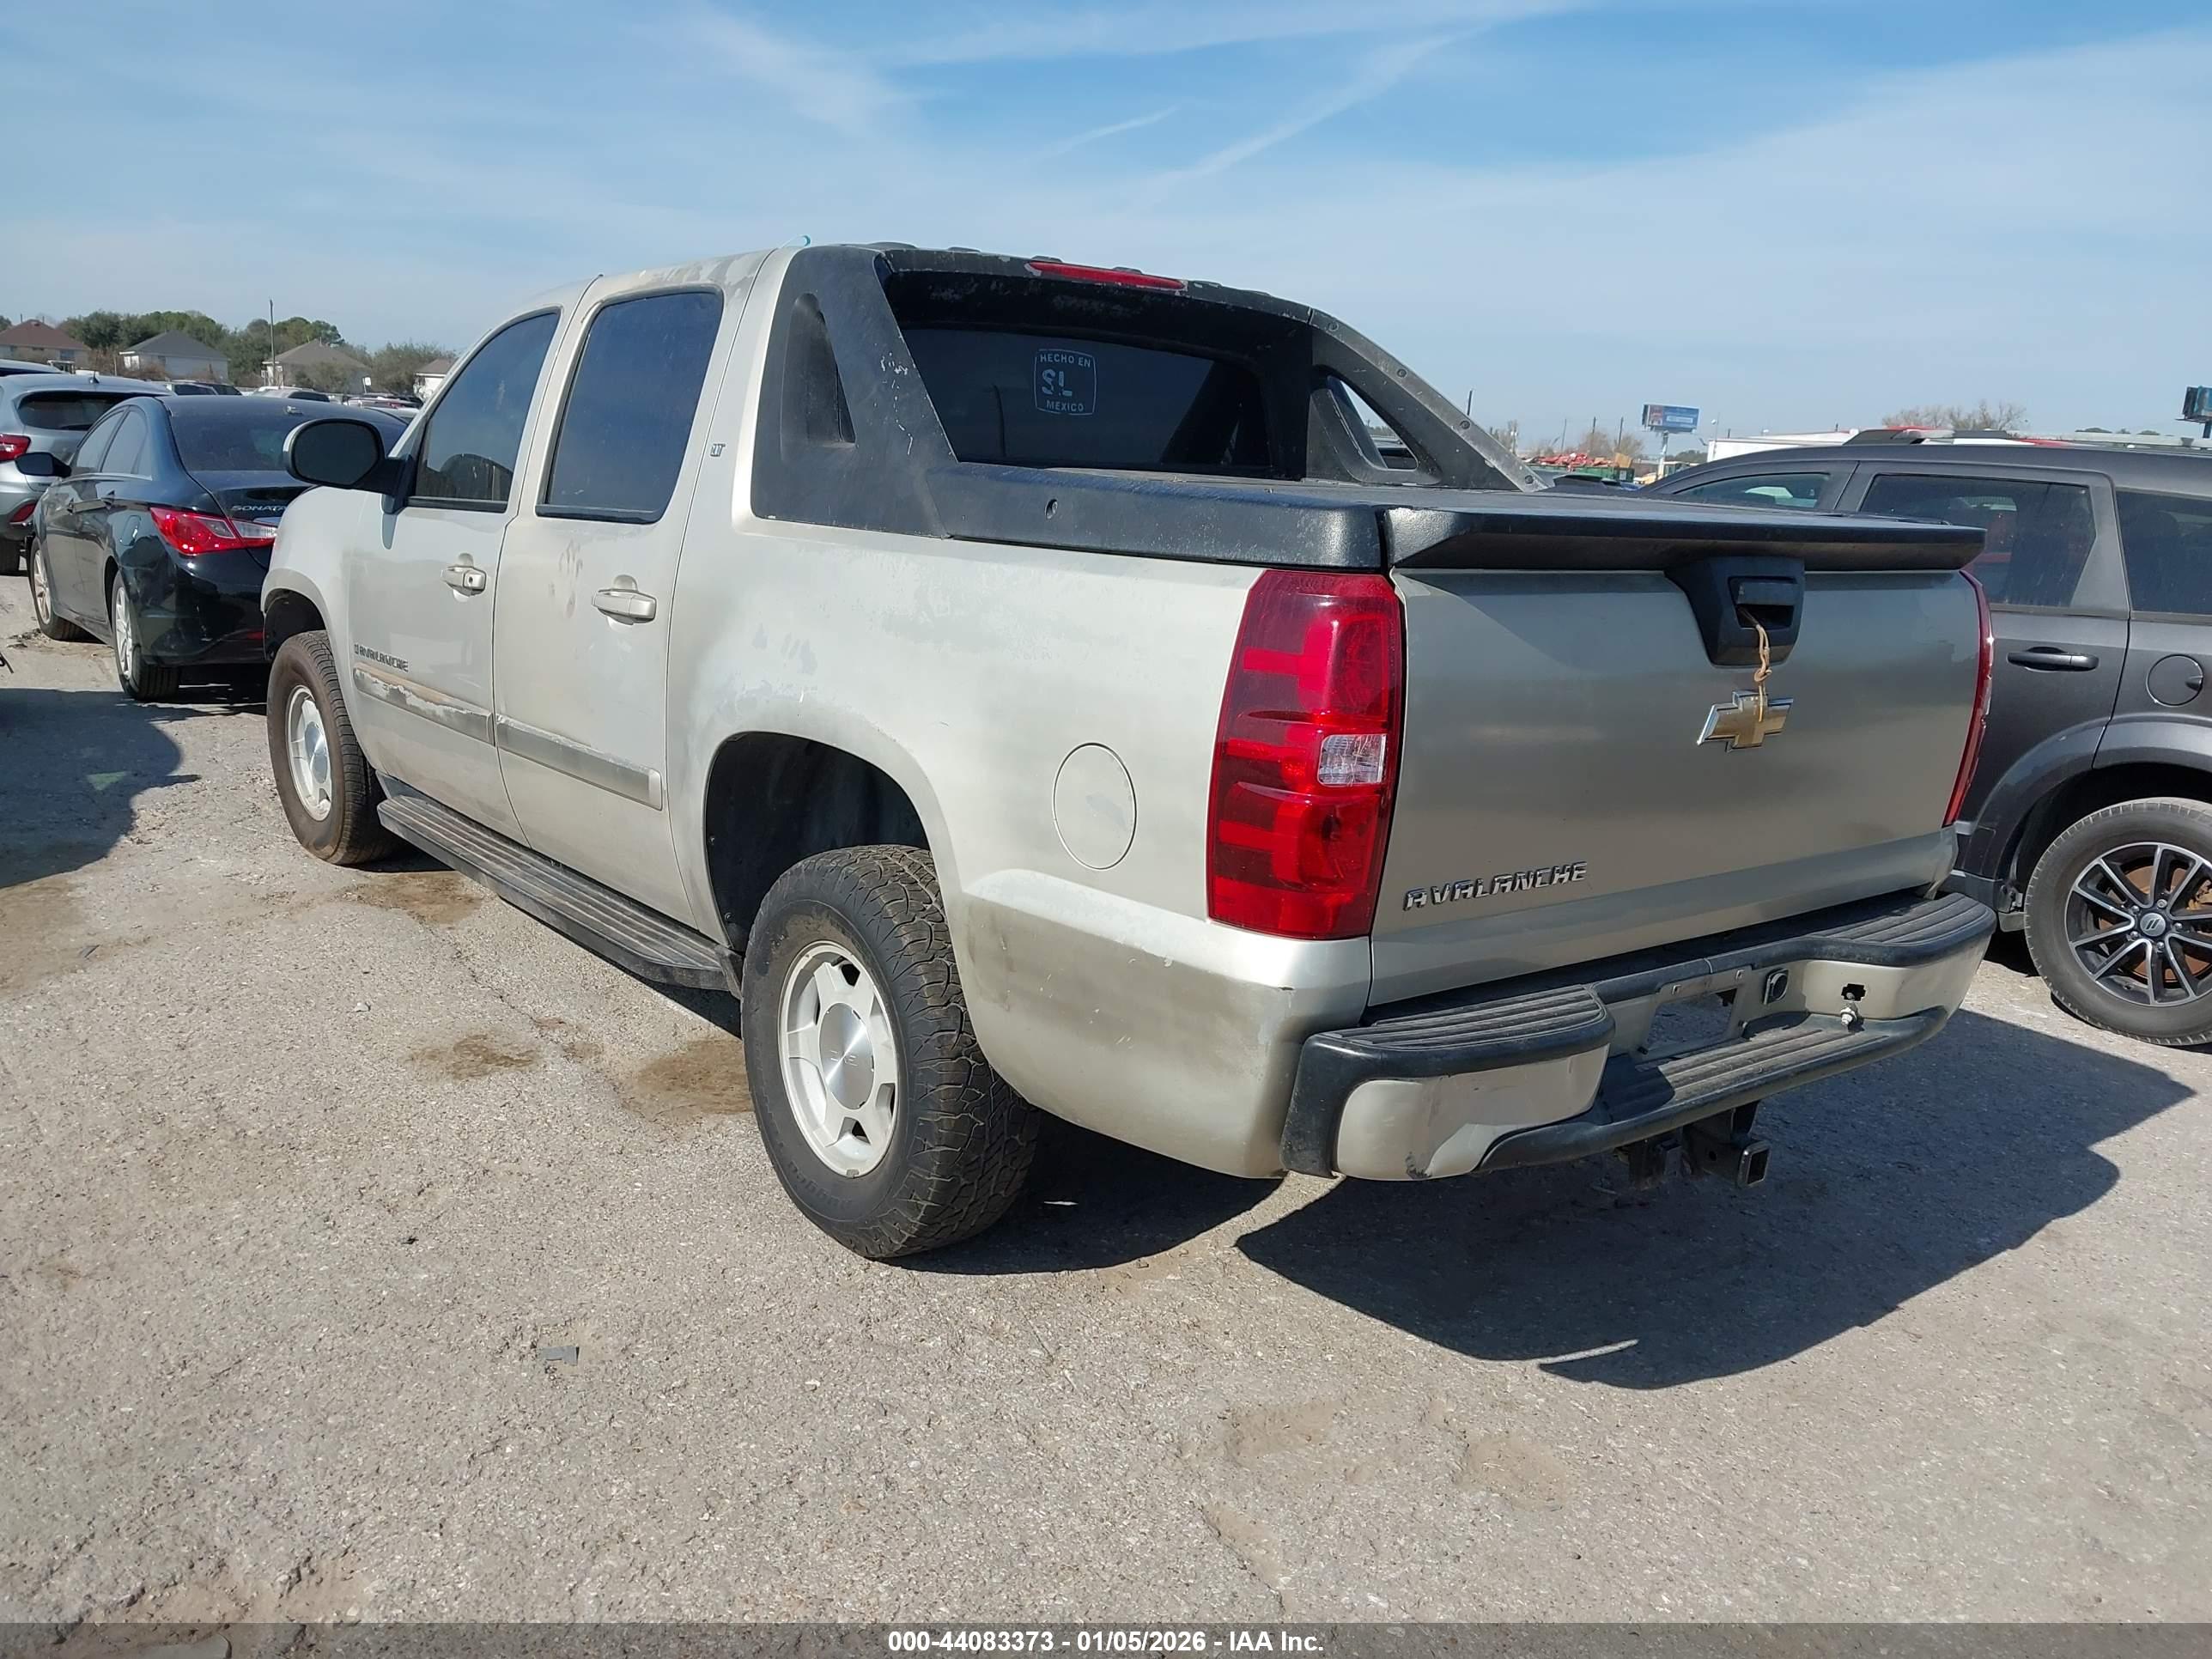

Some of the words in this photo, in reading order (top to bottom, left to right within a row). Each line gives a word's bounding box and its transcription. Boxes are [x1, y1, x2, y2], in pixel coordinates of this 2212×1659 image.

[1040, 353, 1074, 364] HECHO
[1078, 356, 1091, 368] EN
[1046, 399, 1084, 412] MEXICO
[710, 443, 726, 457] LT
[1402, 860, 1588, 912] AVALANCHE
